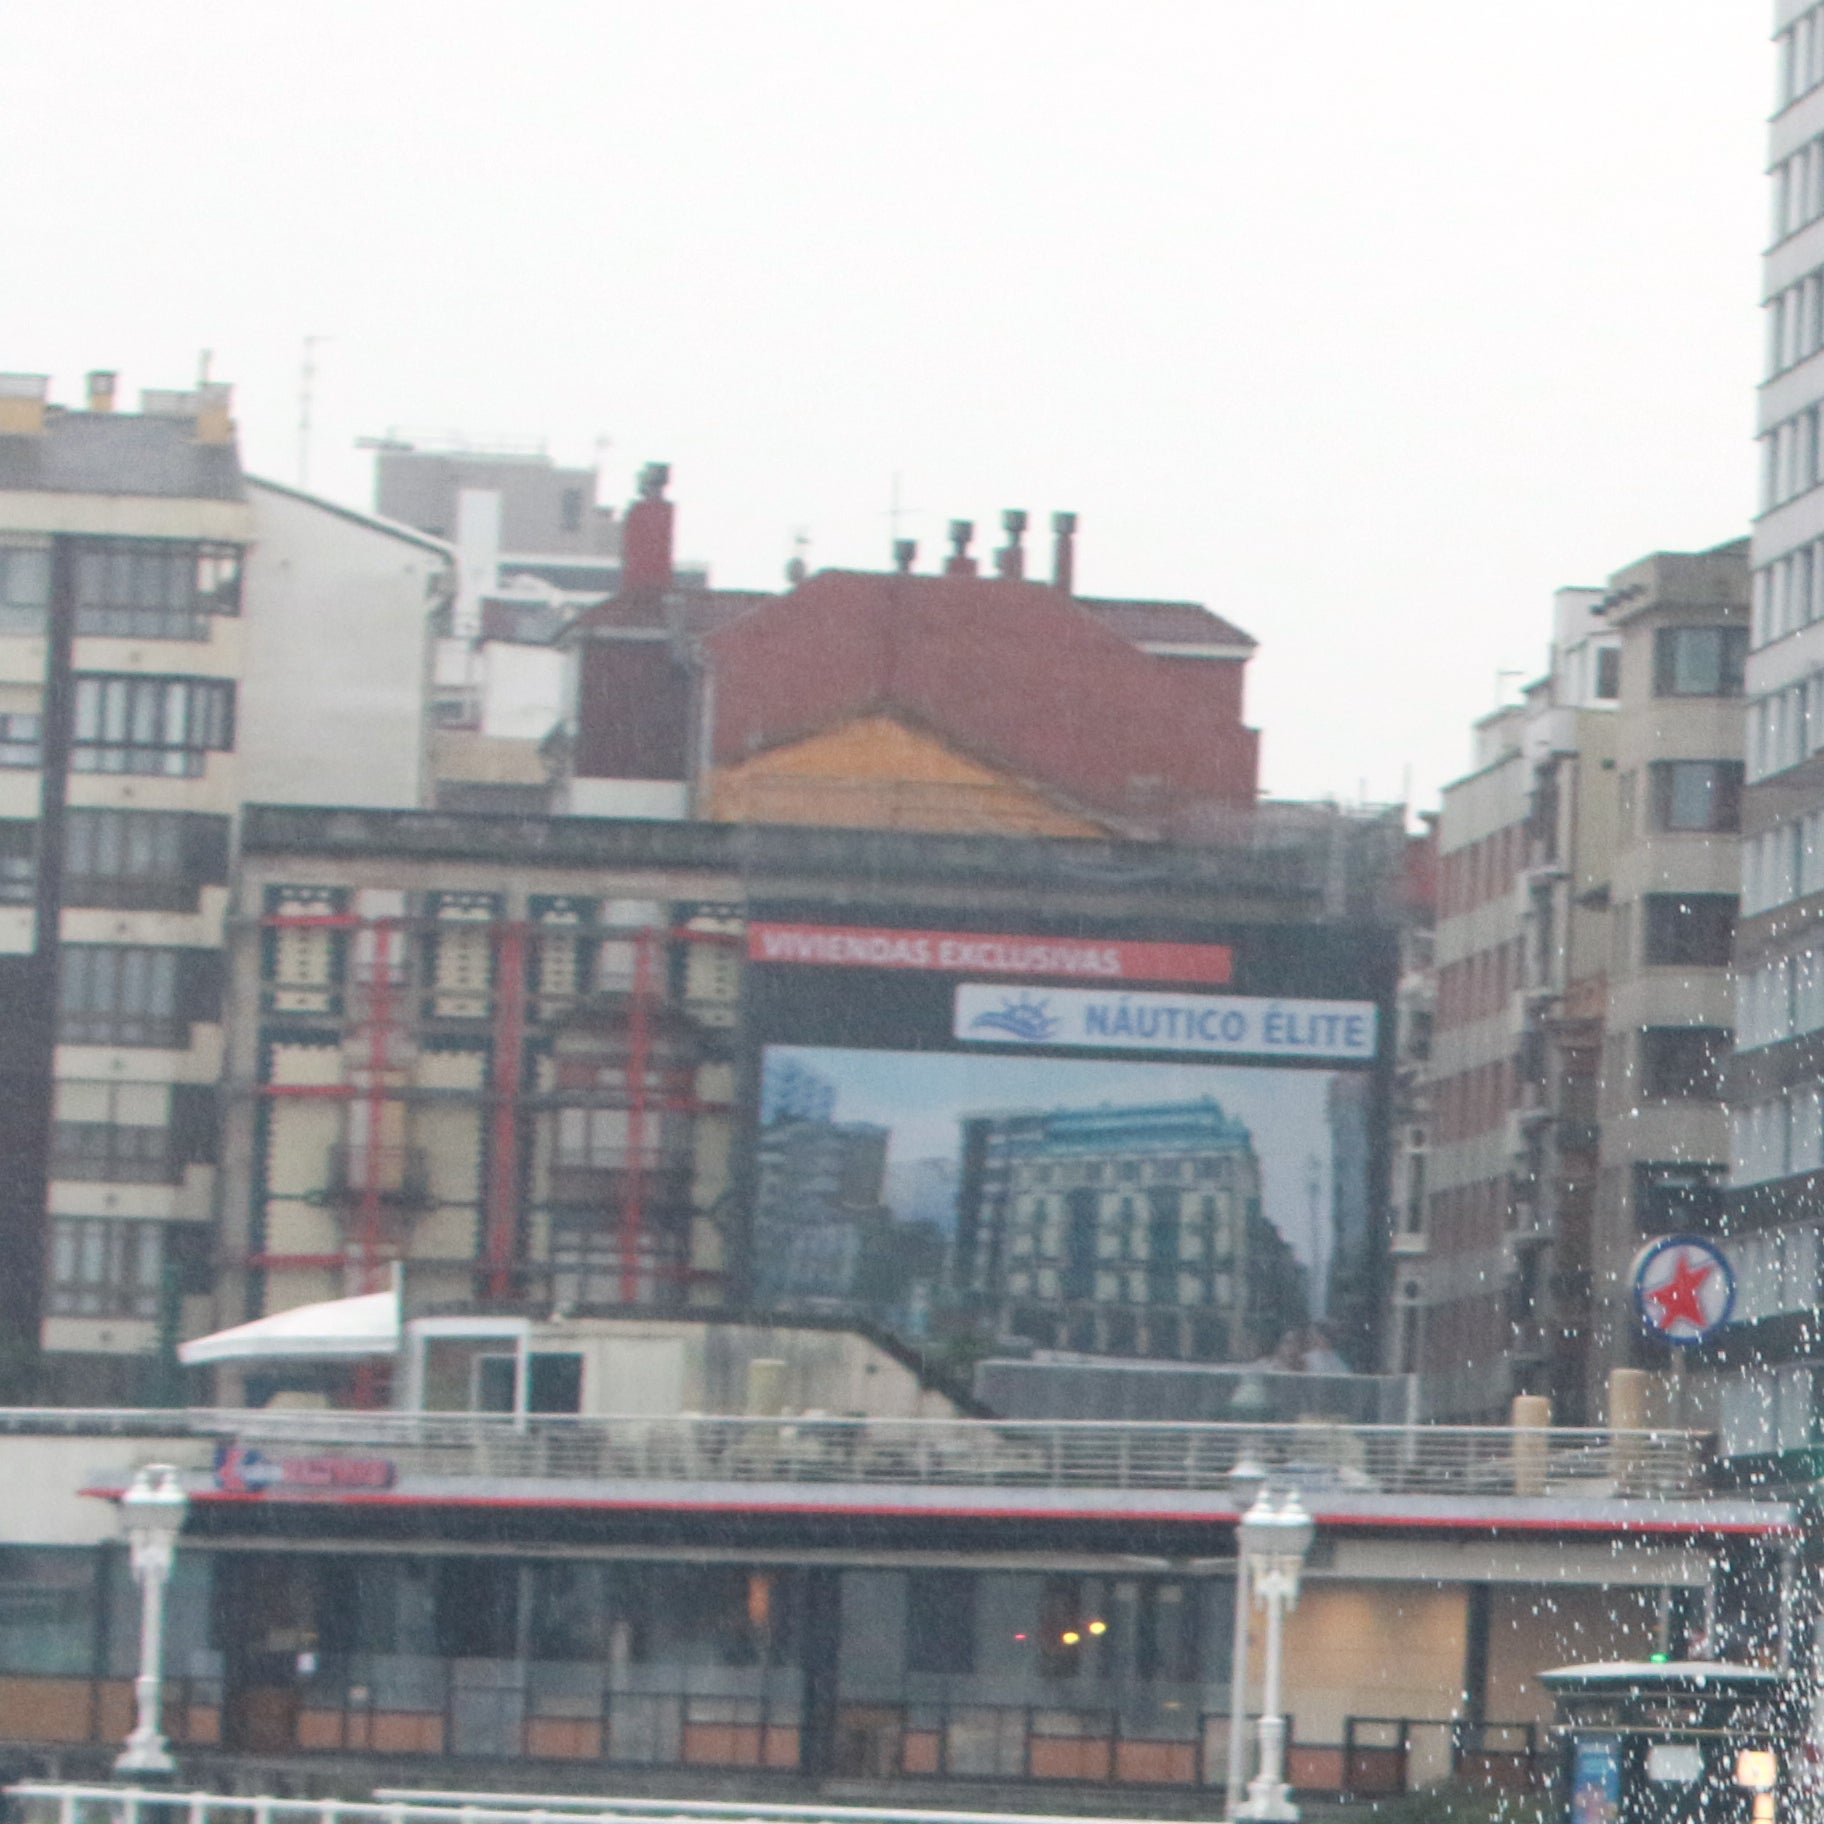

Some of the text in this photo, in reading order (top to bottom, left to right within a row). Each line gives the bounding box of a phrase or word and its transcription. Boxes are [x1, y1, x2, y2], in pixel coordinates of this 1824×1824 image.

[763, 932, 1122, 976] VIVIENDAS EXCLUSIVAS
[1085, 996, 1365, 1048] NÁUTICO ÉLITE
